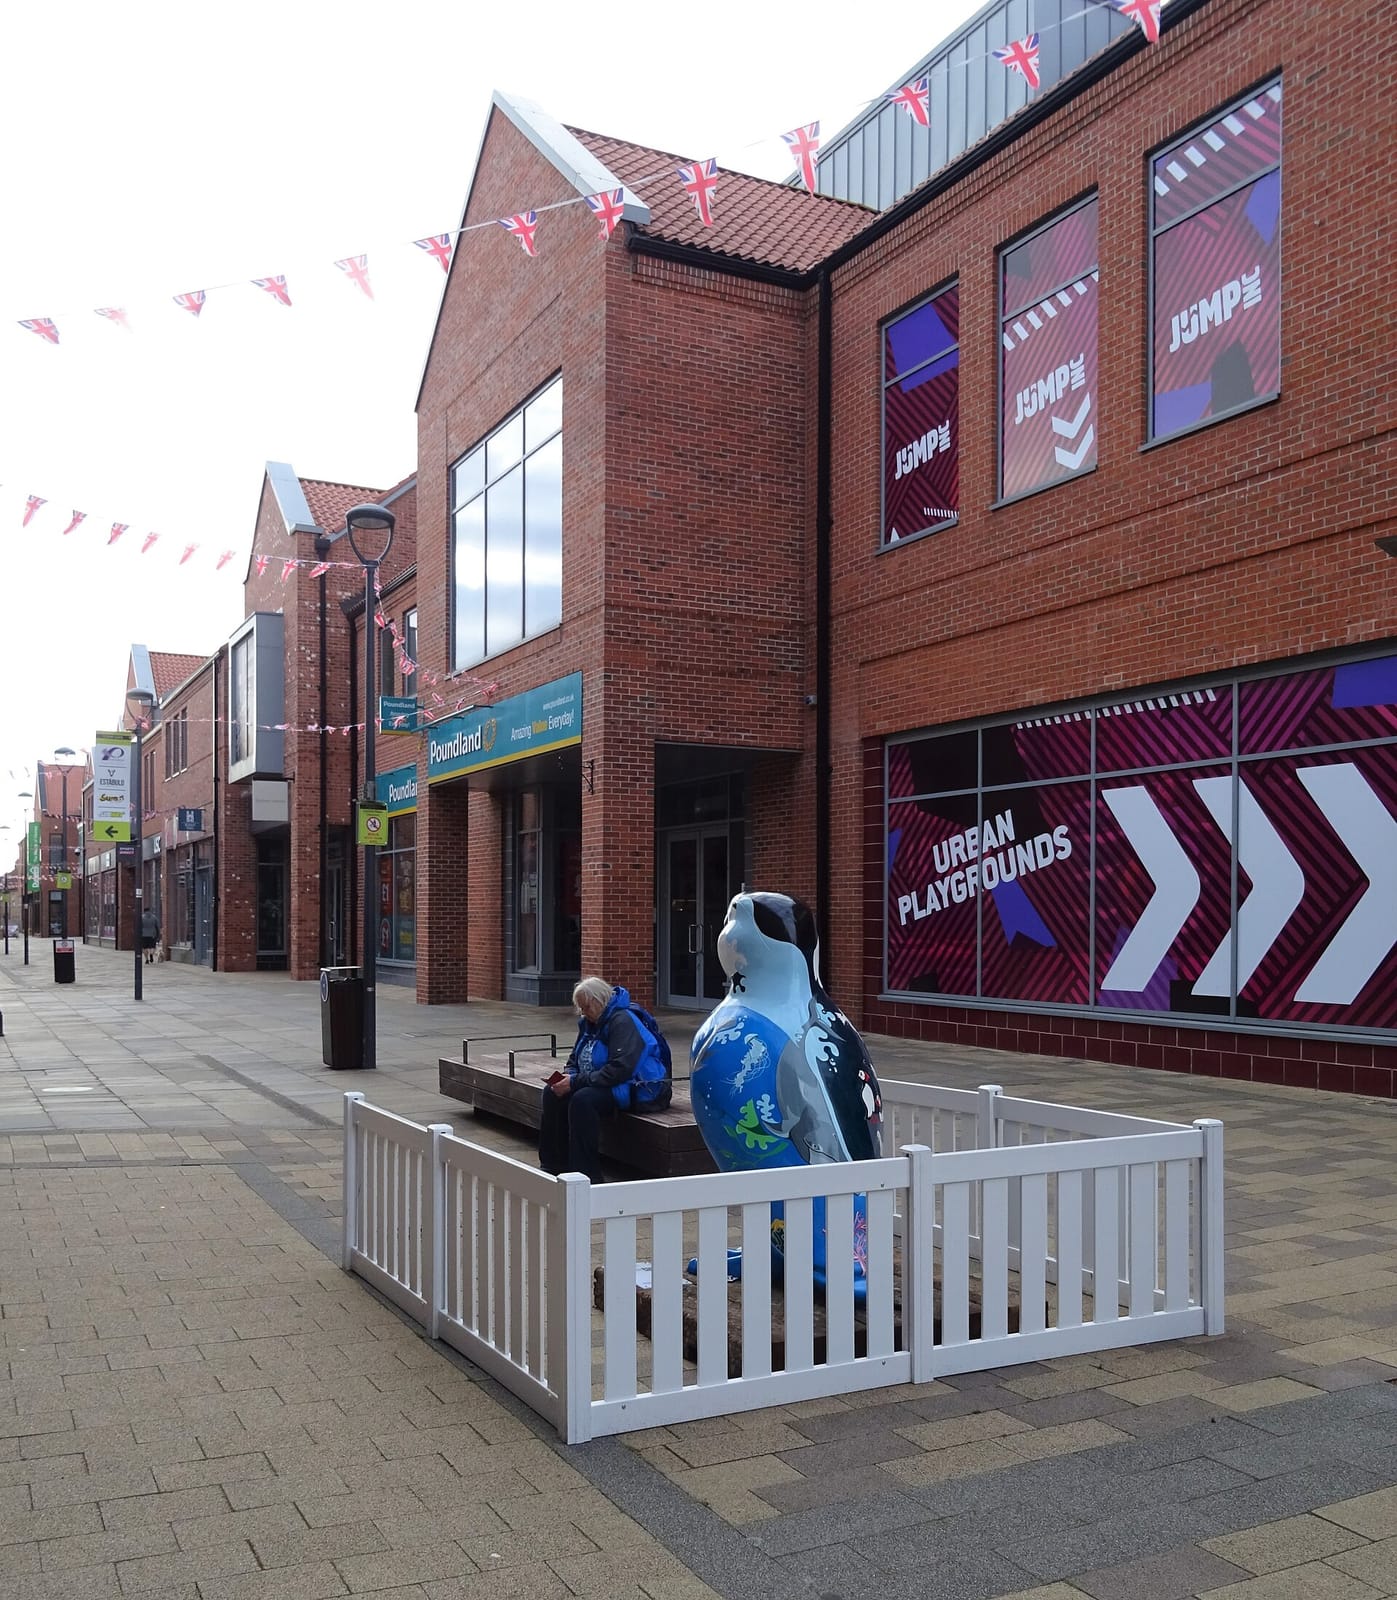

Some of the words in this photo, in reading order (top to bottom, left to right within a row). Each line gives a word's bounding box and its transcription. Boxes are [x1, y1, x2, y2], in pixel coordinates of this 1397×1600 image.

[1169, 289, 1242, 353] JUMP
[1242, 265, 1262, 310] INC
[1015, 363, 1070, 425] JUMP
[1070, 352, 1086, 391] INC
[895, 430, 938, 480] JUMP
[938, 419, 951, 453] INC
[383, 701, 415, 709] Poundland
[511, 724, 532, 741] Amazing
[548, 708, 575, 730] Everyday!
[430, 725, 482, 764] Poundland
[933, 808, 1016, 874] URBAN
[897, 824, 1073, 926] PLAYGROUNDS
